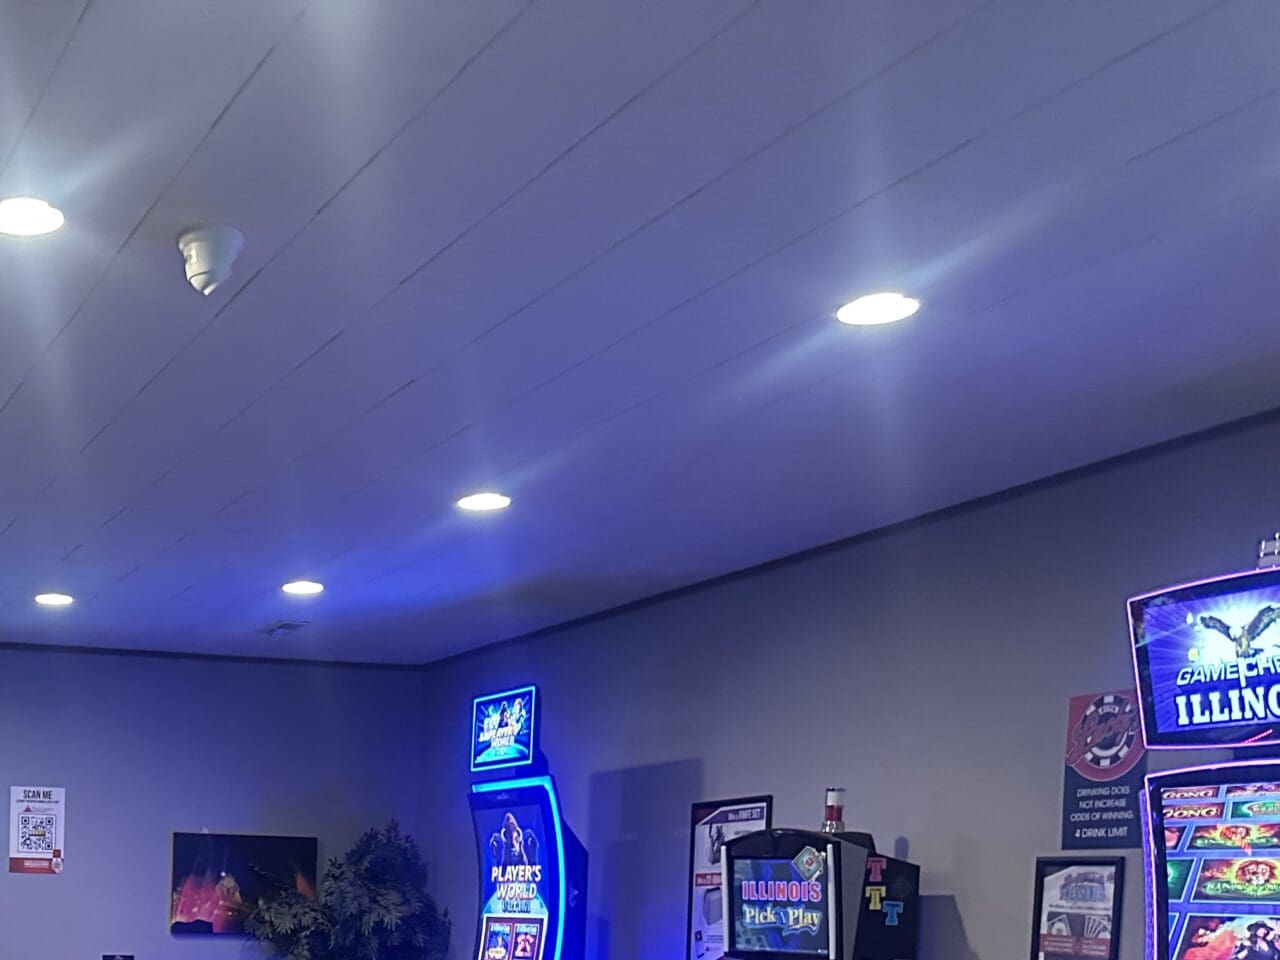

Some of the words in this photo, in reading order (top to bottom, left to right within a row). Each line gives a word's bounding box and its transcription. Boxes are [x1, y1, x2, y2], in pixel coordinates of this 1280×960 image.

[23, 789, 41, 799] SCAN
[42, 790, 52, 800] ME
[1070, 812, 1090, 822] ODDS
[1082, 828, 1107, 838] DRINK
[1108, 826, 1128, 837] LIMIT
[491, 865, 541, 882] PLAYER'S
[496, 883, 537, 900] WORLD
[742, 881, 822, 902] ILLINOIS
[787, 907, 821, 930] Play
